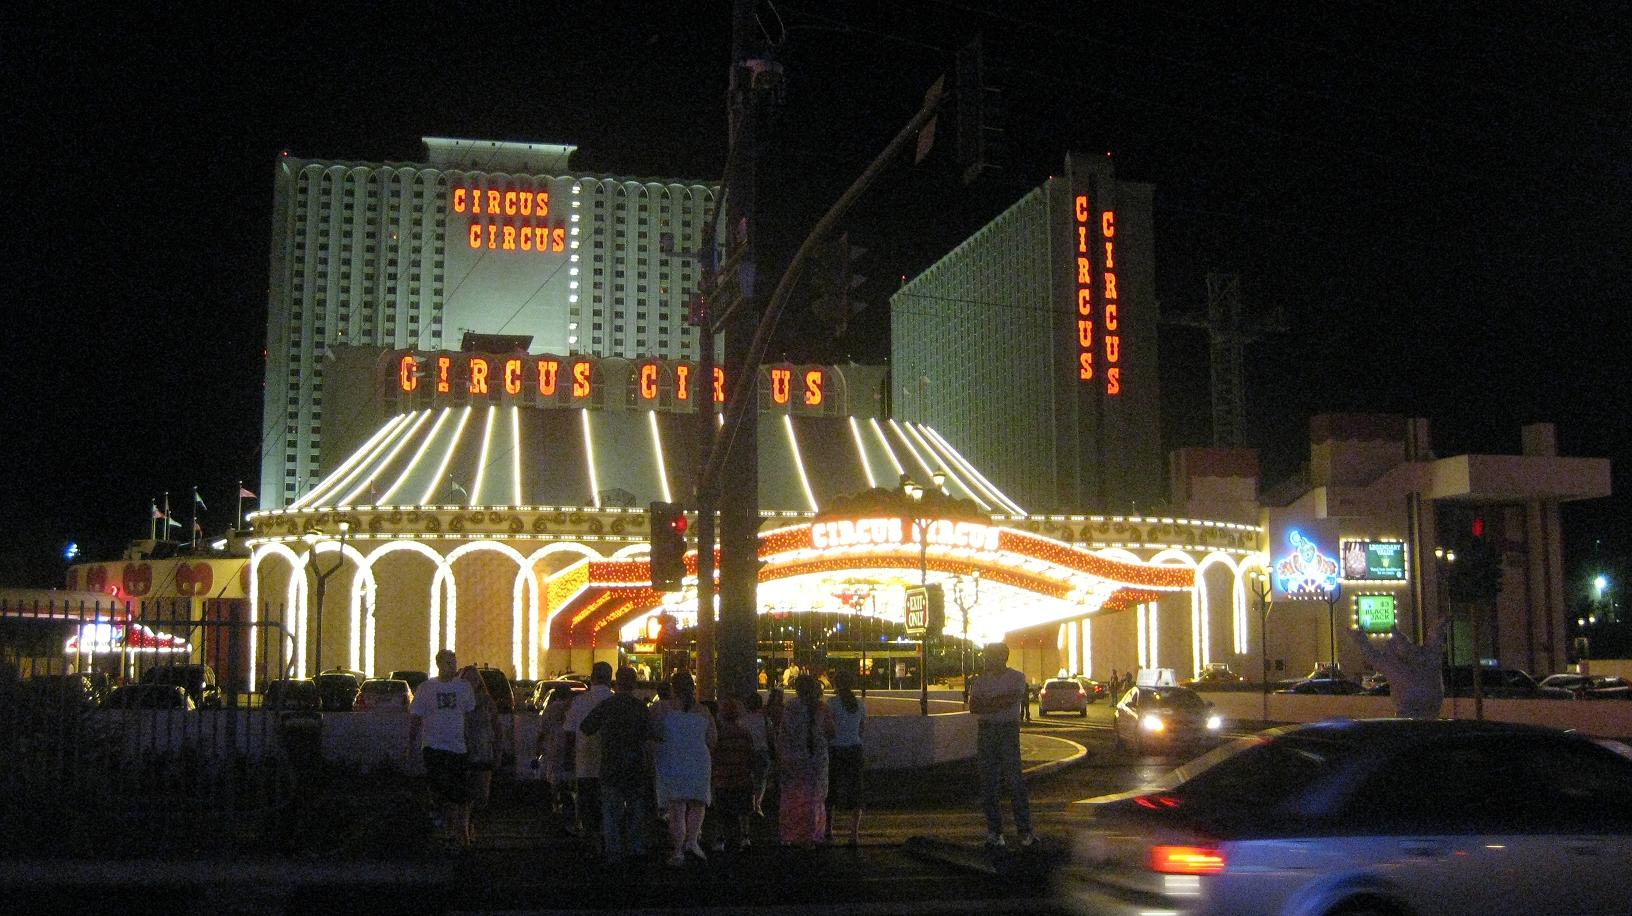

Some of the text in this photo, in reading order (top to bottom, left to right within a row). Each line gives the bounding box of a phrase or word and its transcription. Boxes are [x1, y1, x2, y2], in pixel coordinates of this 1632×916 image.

[453, 188, 549, 217] CIRCUS
[469, 224, 566, 253] CIRCUS
[1076, 196, 1093, 380] CIRCUS
[1102, 211, 1120, 394] CIRCUS
[400, 355, 823, 405] CIRCUS CIRUS
[811, 518, 902, 548] CIRCUS
[909, 595, 924, 611] EXIT
[908, 611, 924, 627] ONLY
